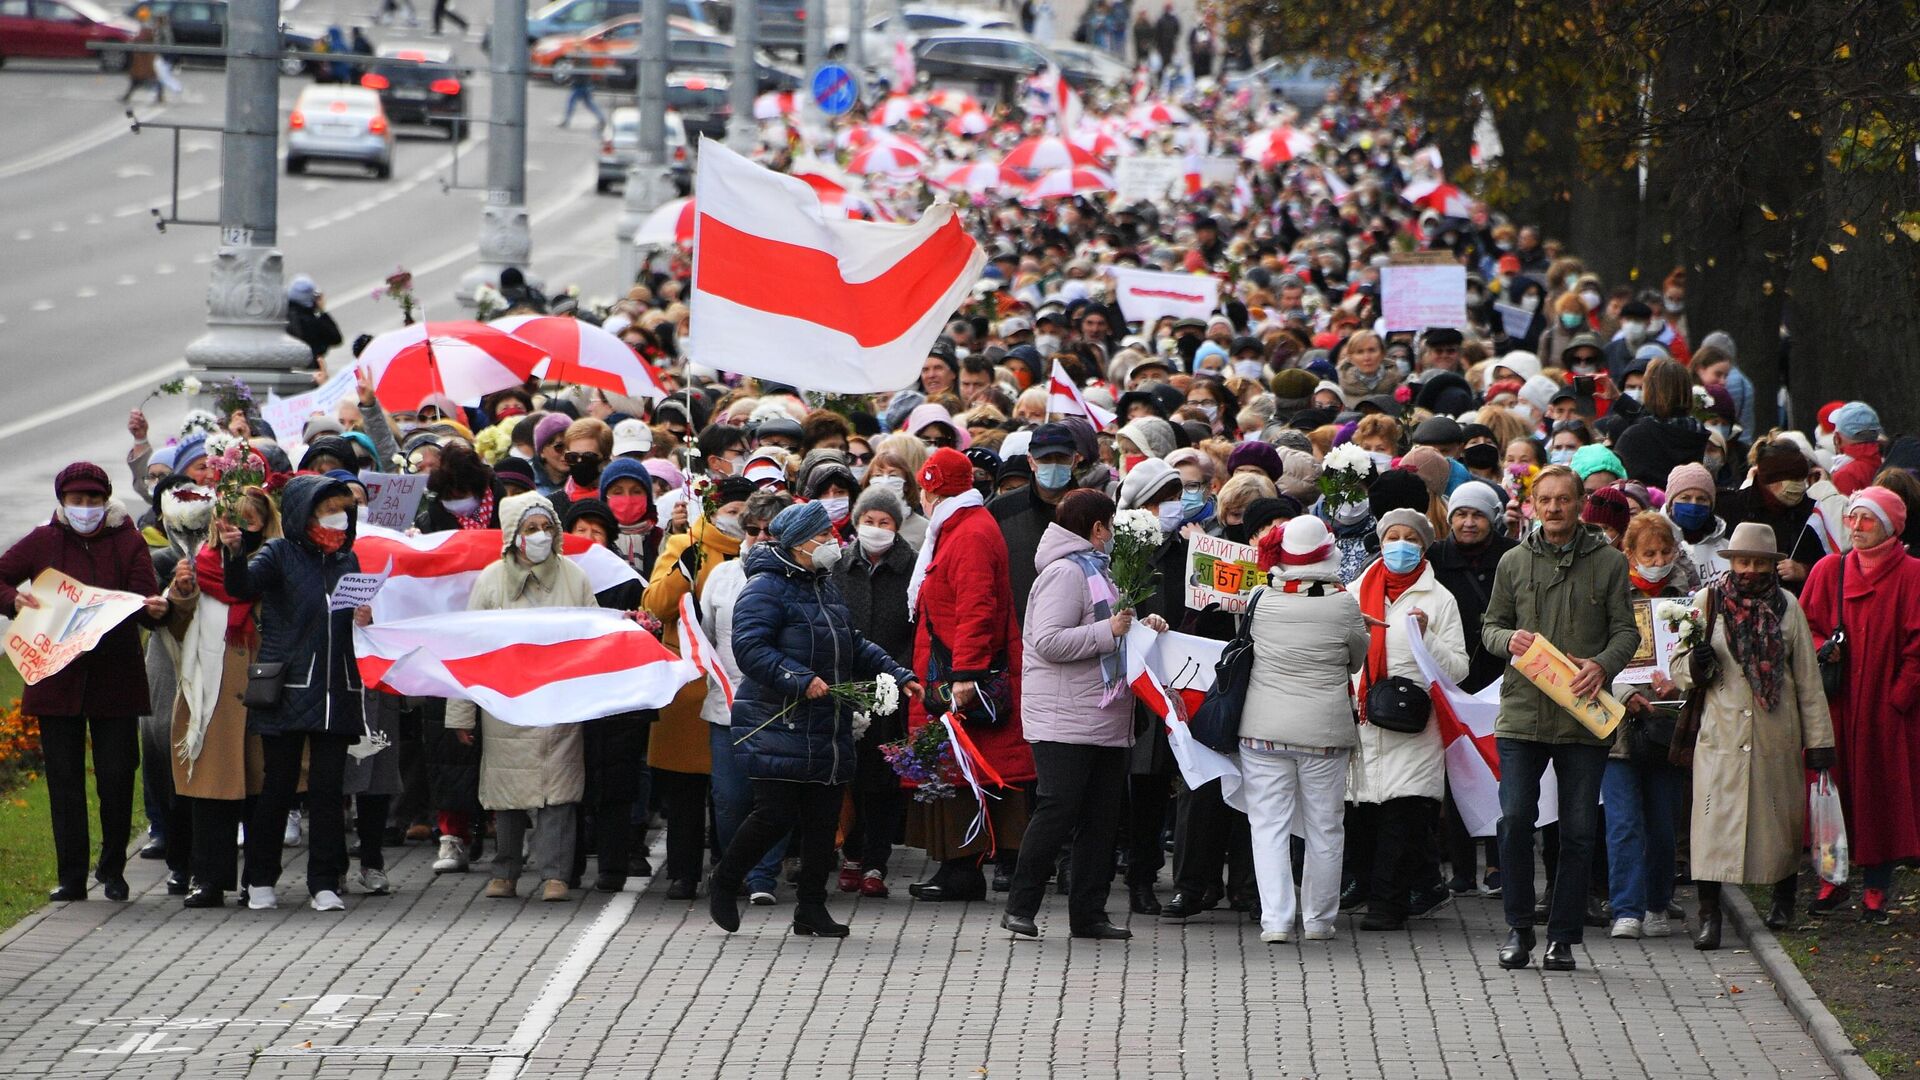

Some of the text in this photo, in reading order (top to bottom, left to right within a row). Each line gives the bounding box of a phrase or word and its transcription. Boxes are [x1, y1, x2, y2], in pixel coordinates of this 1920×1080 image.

[386, 478, 416, 494] МЫ
[381, 496, 400, 510] ЗА
[1195, 535, 1234, 559] ХВАТИТ
[343, 576, 378, 584] ВЛАСТЬ
[1217, 569, 1238, 588] БТ
[57, 580, 83, 604] МЫ
[1193, 590, 1215, 609] НАС
